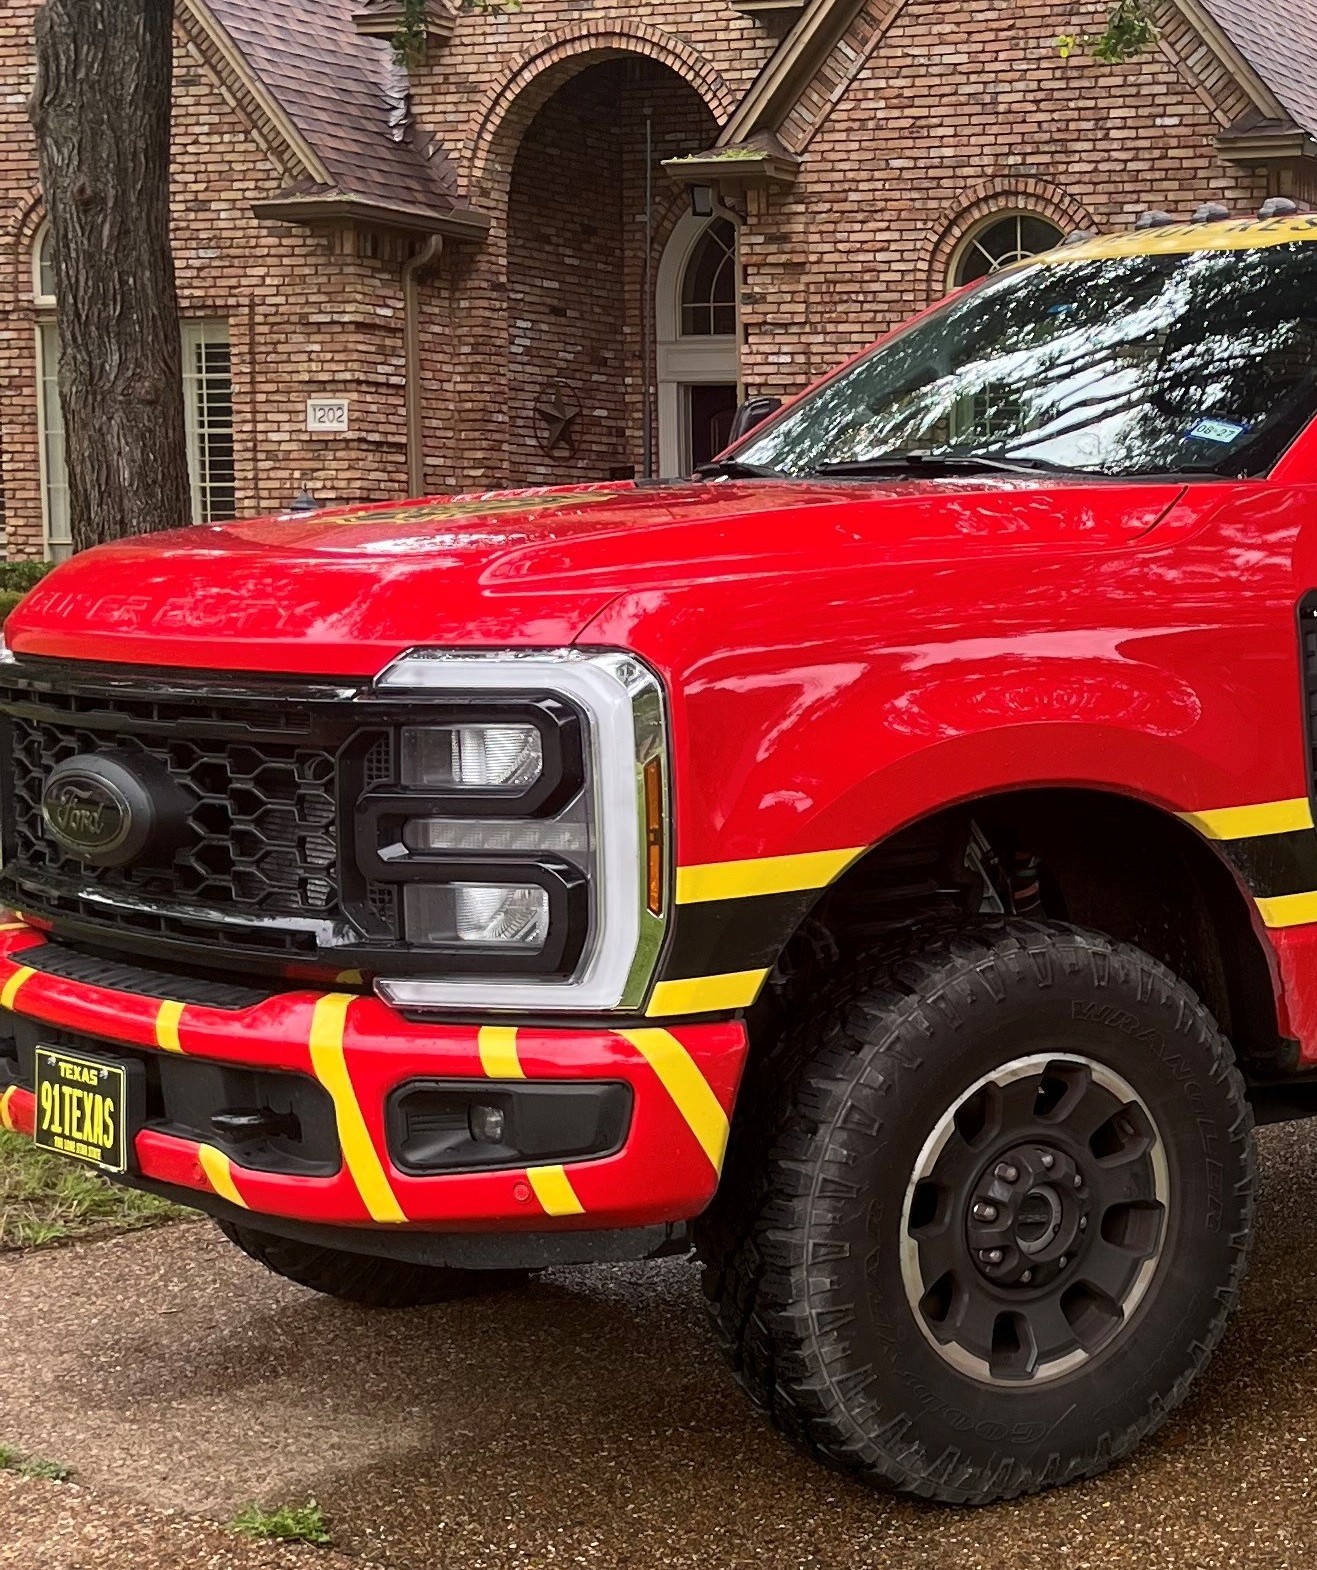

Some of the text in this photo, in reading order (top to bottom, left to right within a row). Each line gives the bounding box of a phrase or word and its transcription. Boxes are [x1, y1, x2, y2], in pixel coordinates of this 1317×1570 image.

[312, 406, 345, 424] 1202
[57, 785, 105, 834] Ford
[58, 1061, 98, 1086] TEXAS
[41, 1080, 115, 1149] 91TEXAS
[1071, 1000, 1226, 1234] WRANGLER
